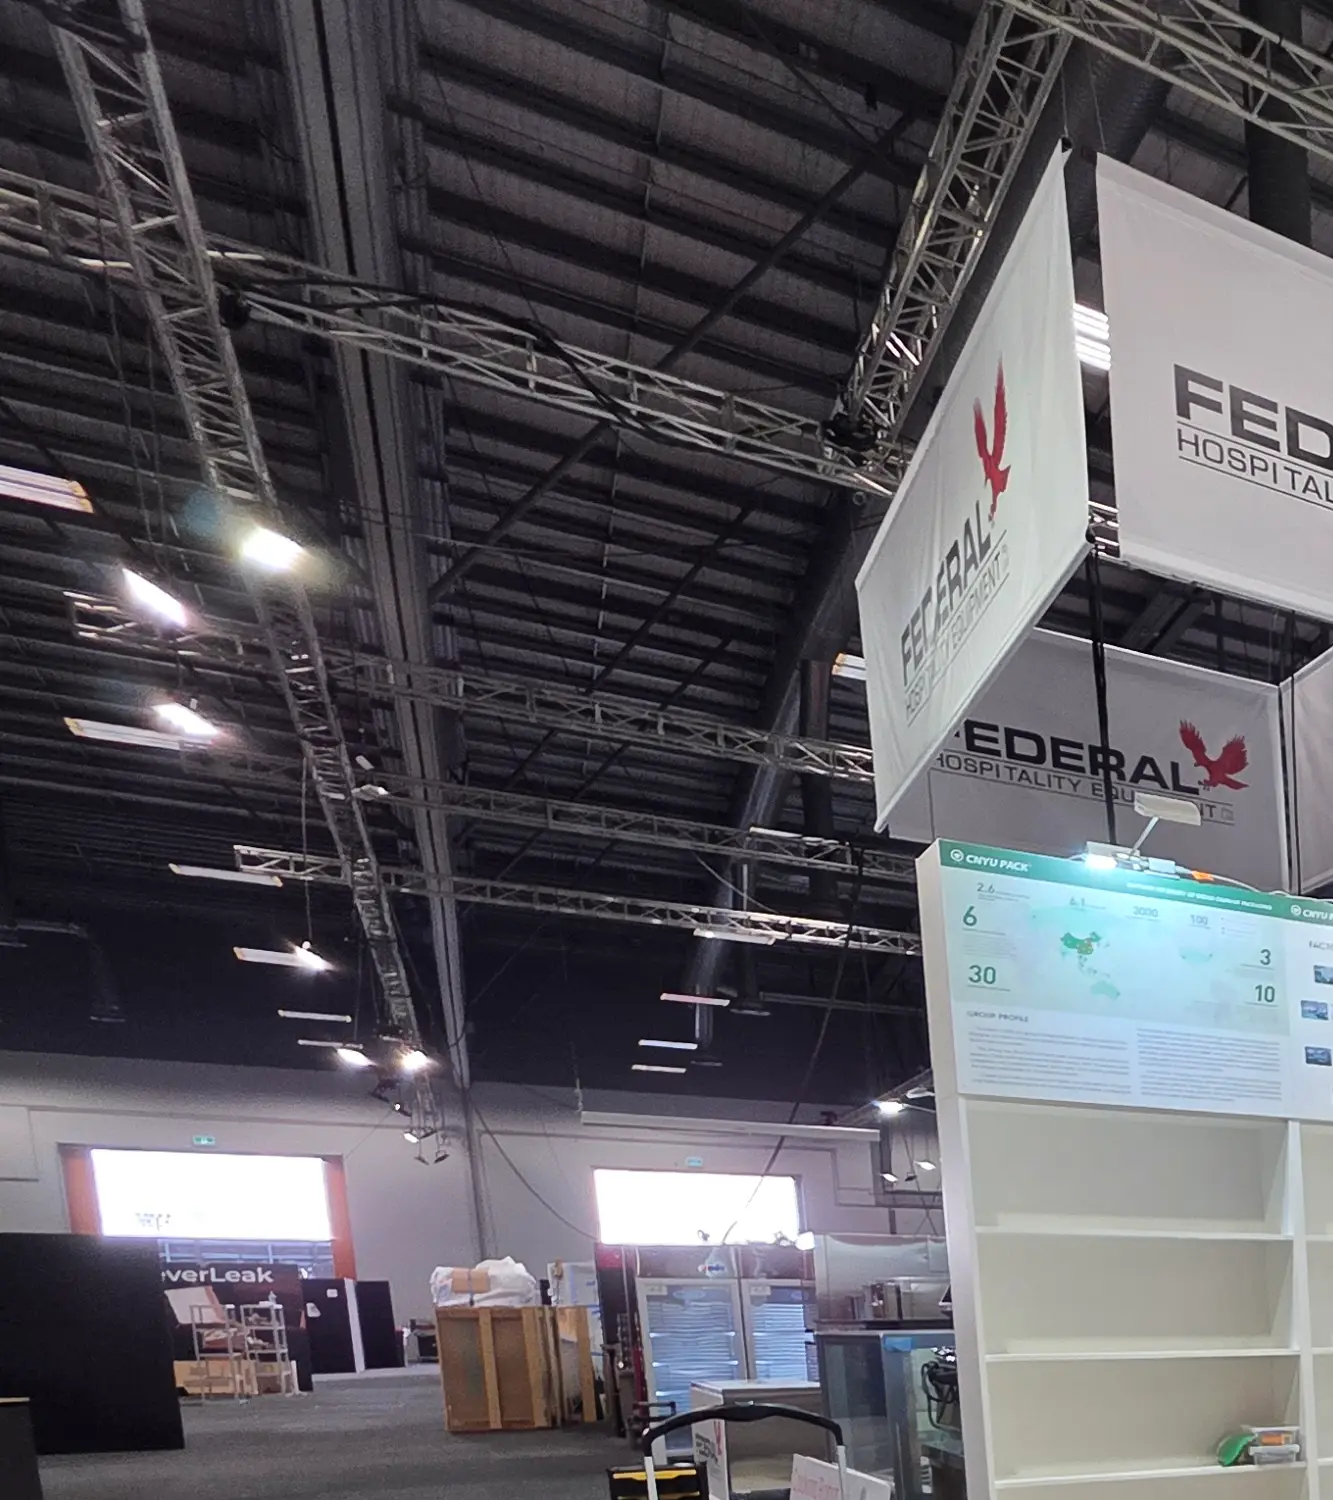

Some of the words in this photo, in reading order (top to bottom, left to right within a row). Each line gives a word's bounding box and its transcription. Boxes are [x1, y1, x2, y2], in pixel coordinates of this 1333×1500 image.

[954, 718, 1200, 796] EDERAL
[1091, 782, 1217, 818] EQUNT
[966, 854, 998, 867] CNYU
[999, 859, 1029, 872] PACK
[962, 906, 977, 927] 6
[1260, 948, 1271, 965] 3
[968, 964, 996, 985] 30
[1255, 984, 1275, 1003] 10
